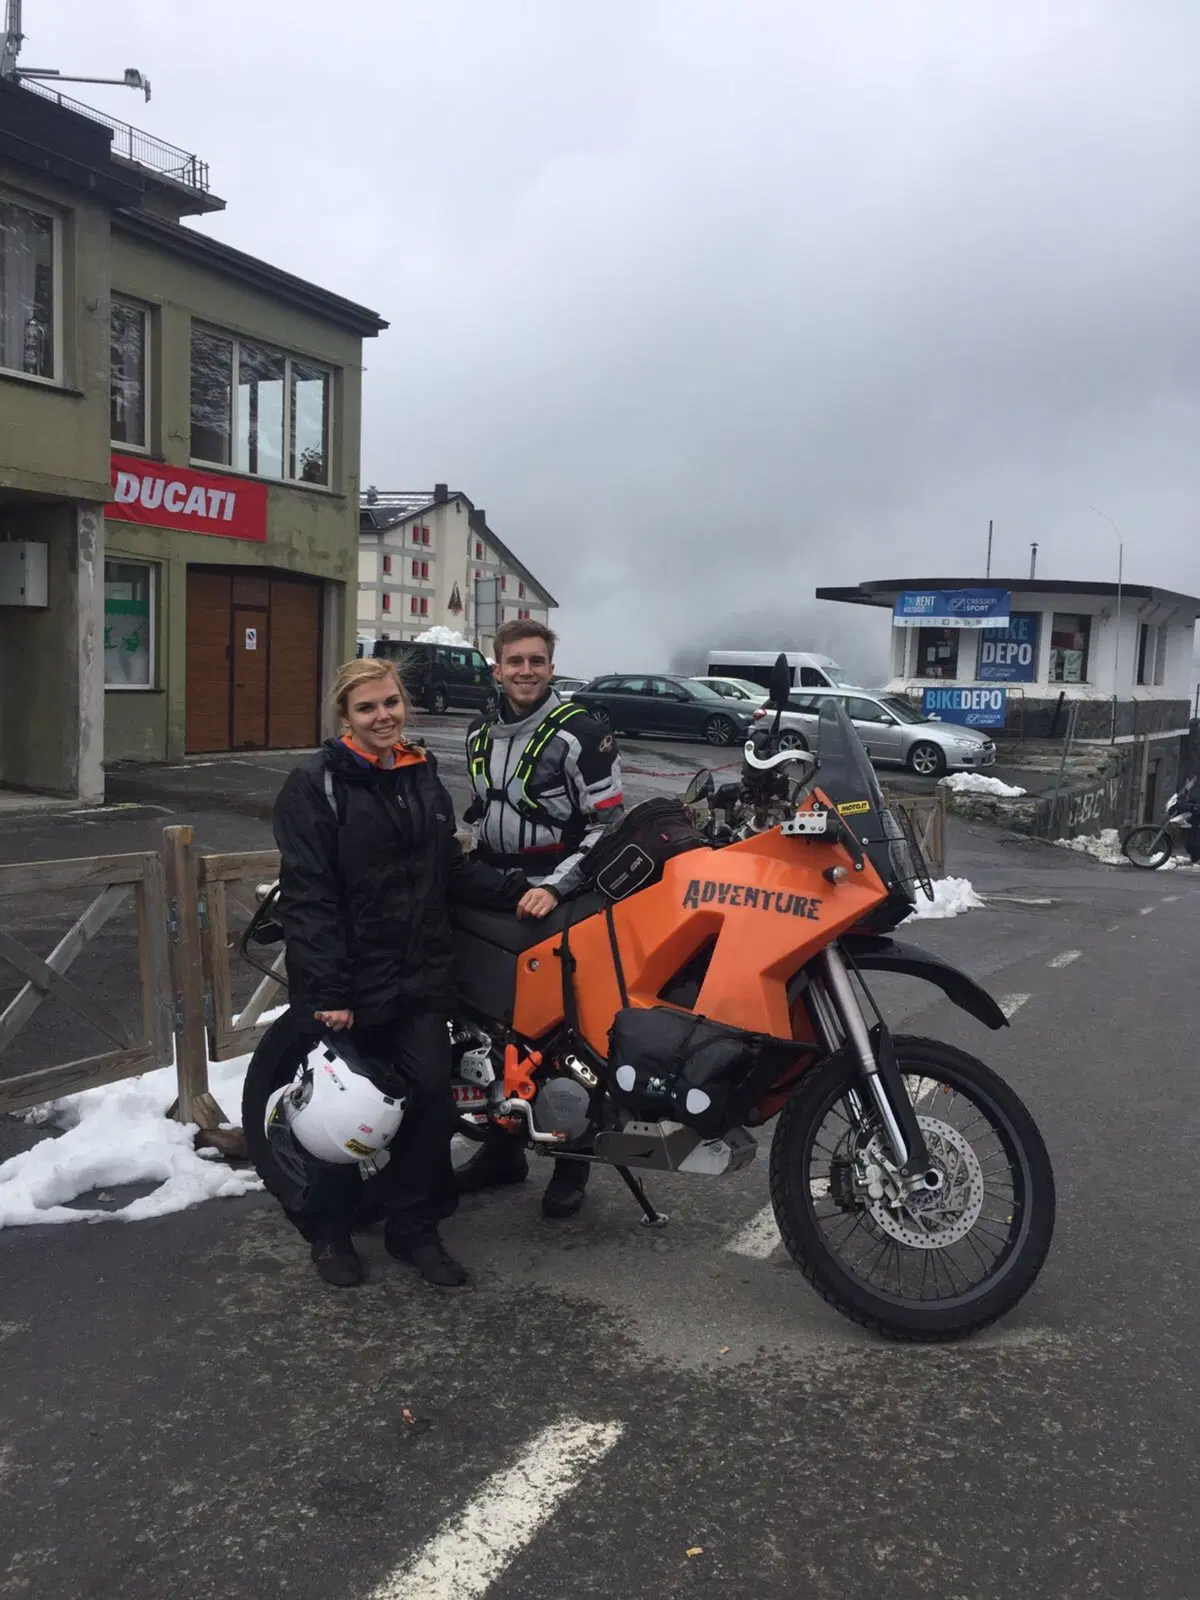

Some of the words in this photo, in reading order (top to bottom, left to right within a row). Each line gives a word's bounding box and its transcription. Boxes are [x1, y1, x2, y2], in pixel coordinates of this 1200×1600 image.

[114, 471, 236, 521] DUCATI
[982, 642, 1032, 666] DEPO
[682, 879, 823, 921] ADVENTURE
